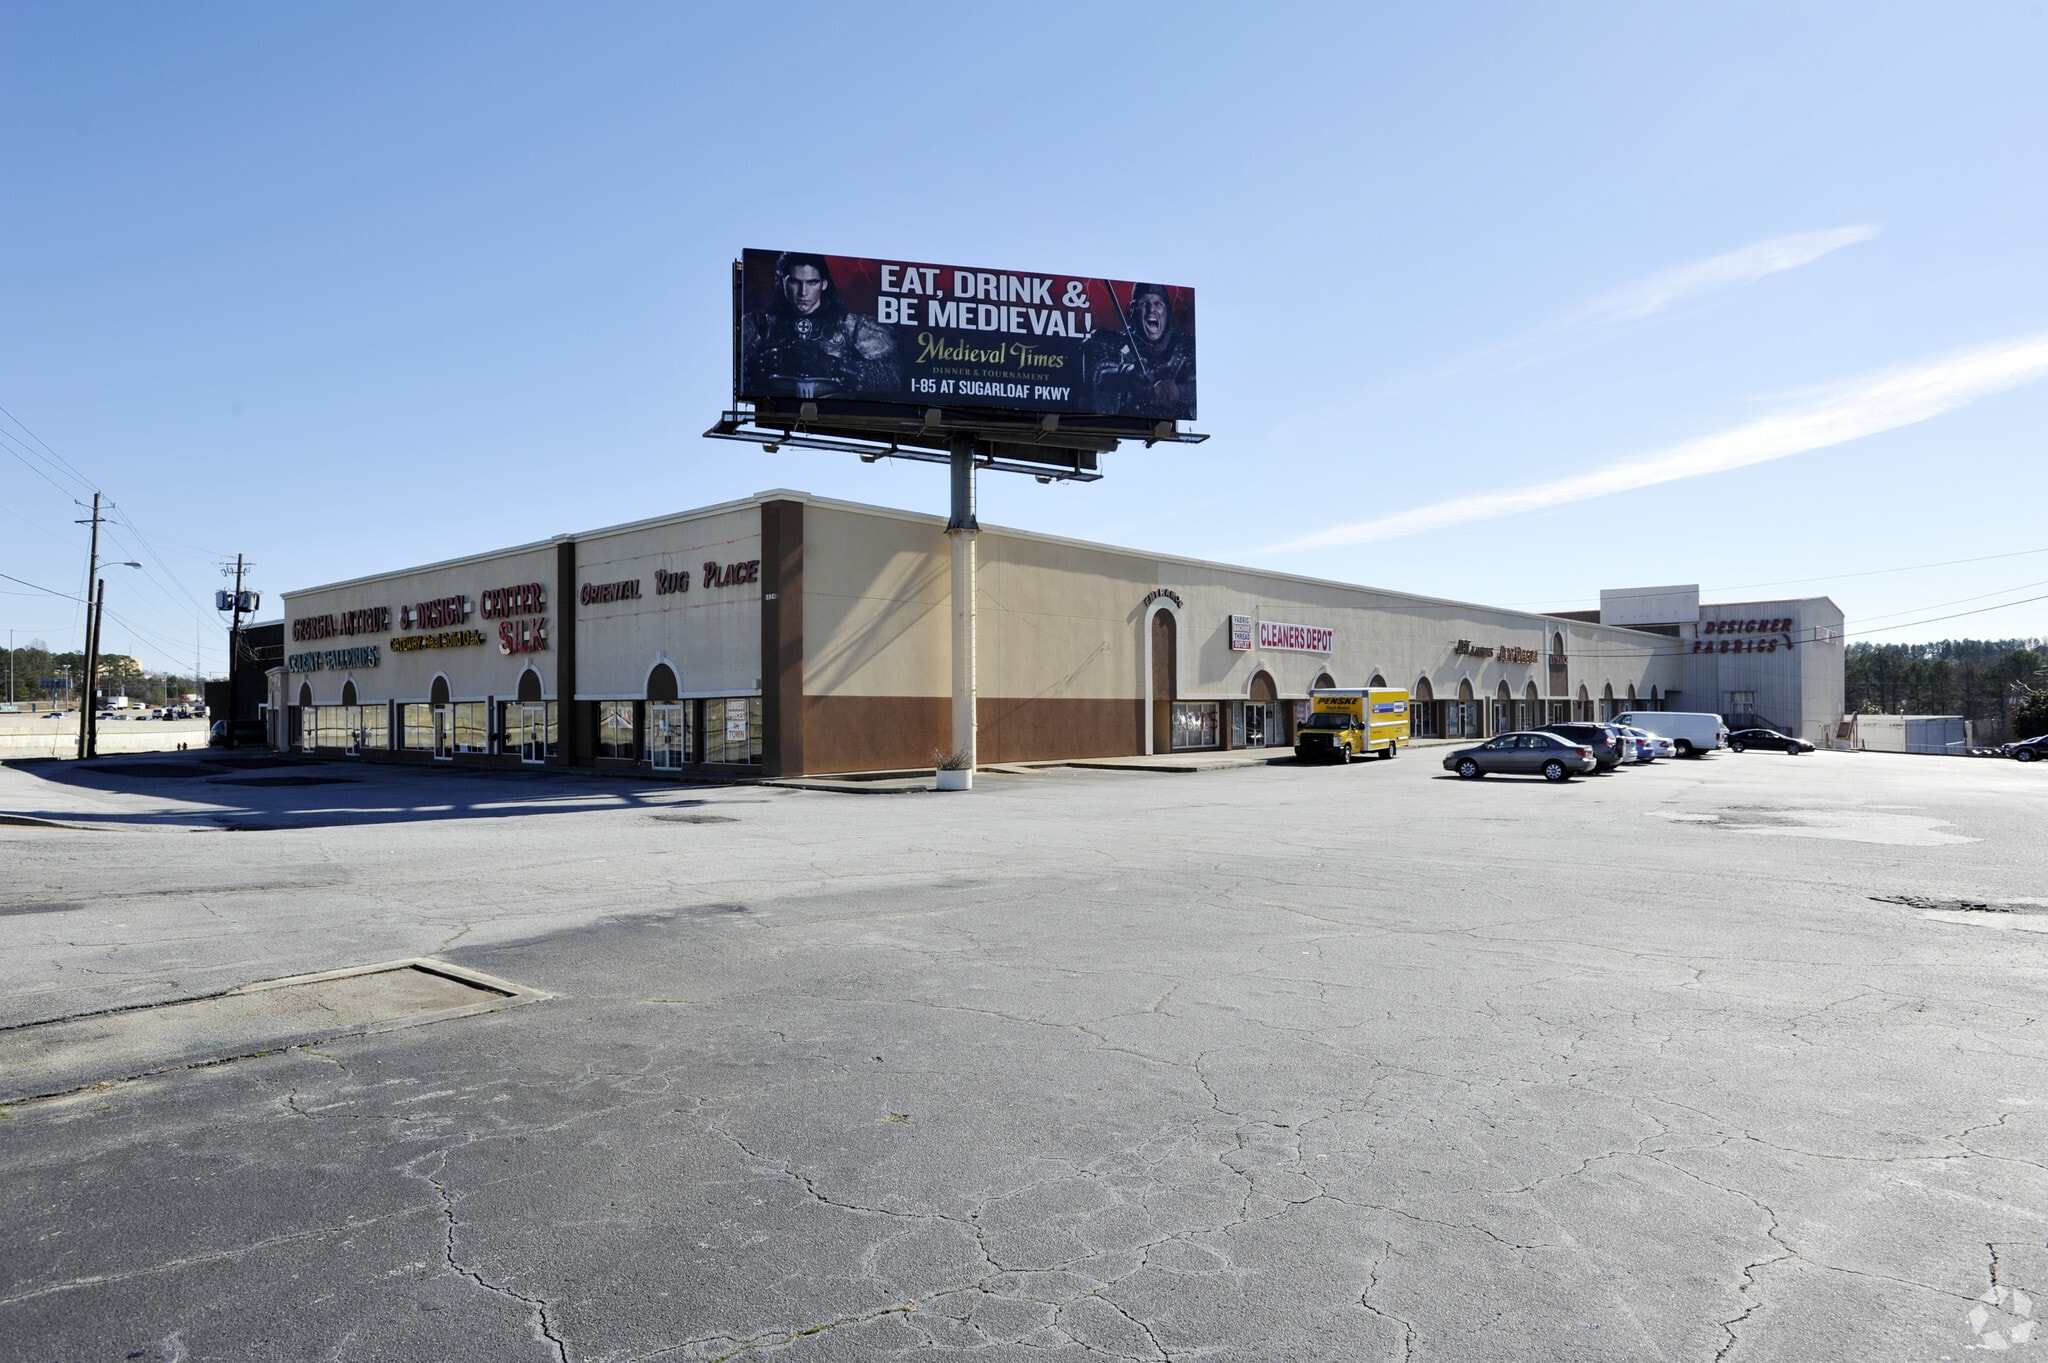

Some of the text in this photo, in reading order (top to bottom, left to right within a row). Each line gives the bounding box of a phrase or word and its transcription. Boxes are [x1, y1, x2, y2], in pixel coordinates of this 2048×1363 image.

[881, 264, 1090, 308] EAT, DRINK &
[877, 295, 1092, 338] BE MEDIEVAL!
[915, 331, 1065, 369] Medieval Times
[932, 366, 1050, 381] DINNER & TOURNAMENT
[911, 378, 1070, 401] I-85 AT SUGARLOAF PKWY
[580, 560, 759, 606] ORIENTAL RUG PLACE
[1144, 588, 1184, 609] ENTRANCE
[292, 582, 543, 642] GEORGIA ANTIQUE & DESIGN CENTER
[1234, 616, 1250, 625] FABRIC
[499, 617, 546, 655] SILK
[1234, 633, 1250, 641] THREAD
[1704, 618, 1792, 634] DESIGNER
[390, 629, 481, 652] GATEWAY Real Solid Oak
[1234, 641, 1250, 649] OUTLET
[1260, 624, 1332, 651] CLEANERS DEPOT
[1694, 639, 1778, 654] FABRICS
[1317, 697, 1359, 705] PENSKE
[728, 731, 745, 739] TOWN
